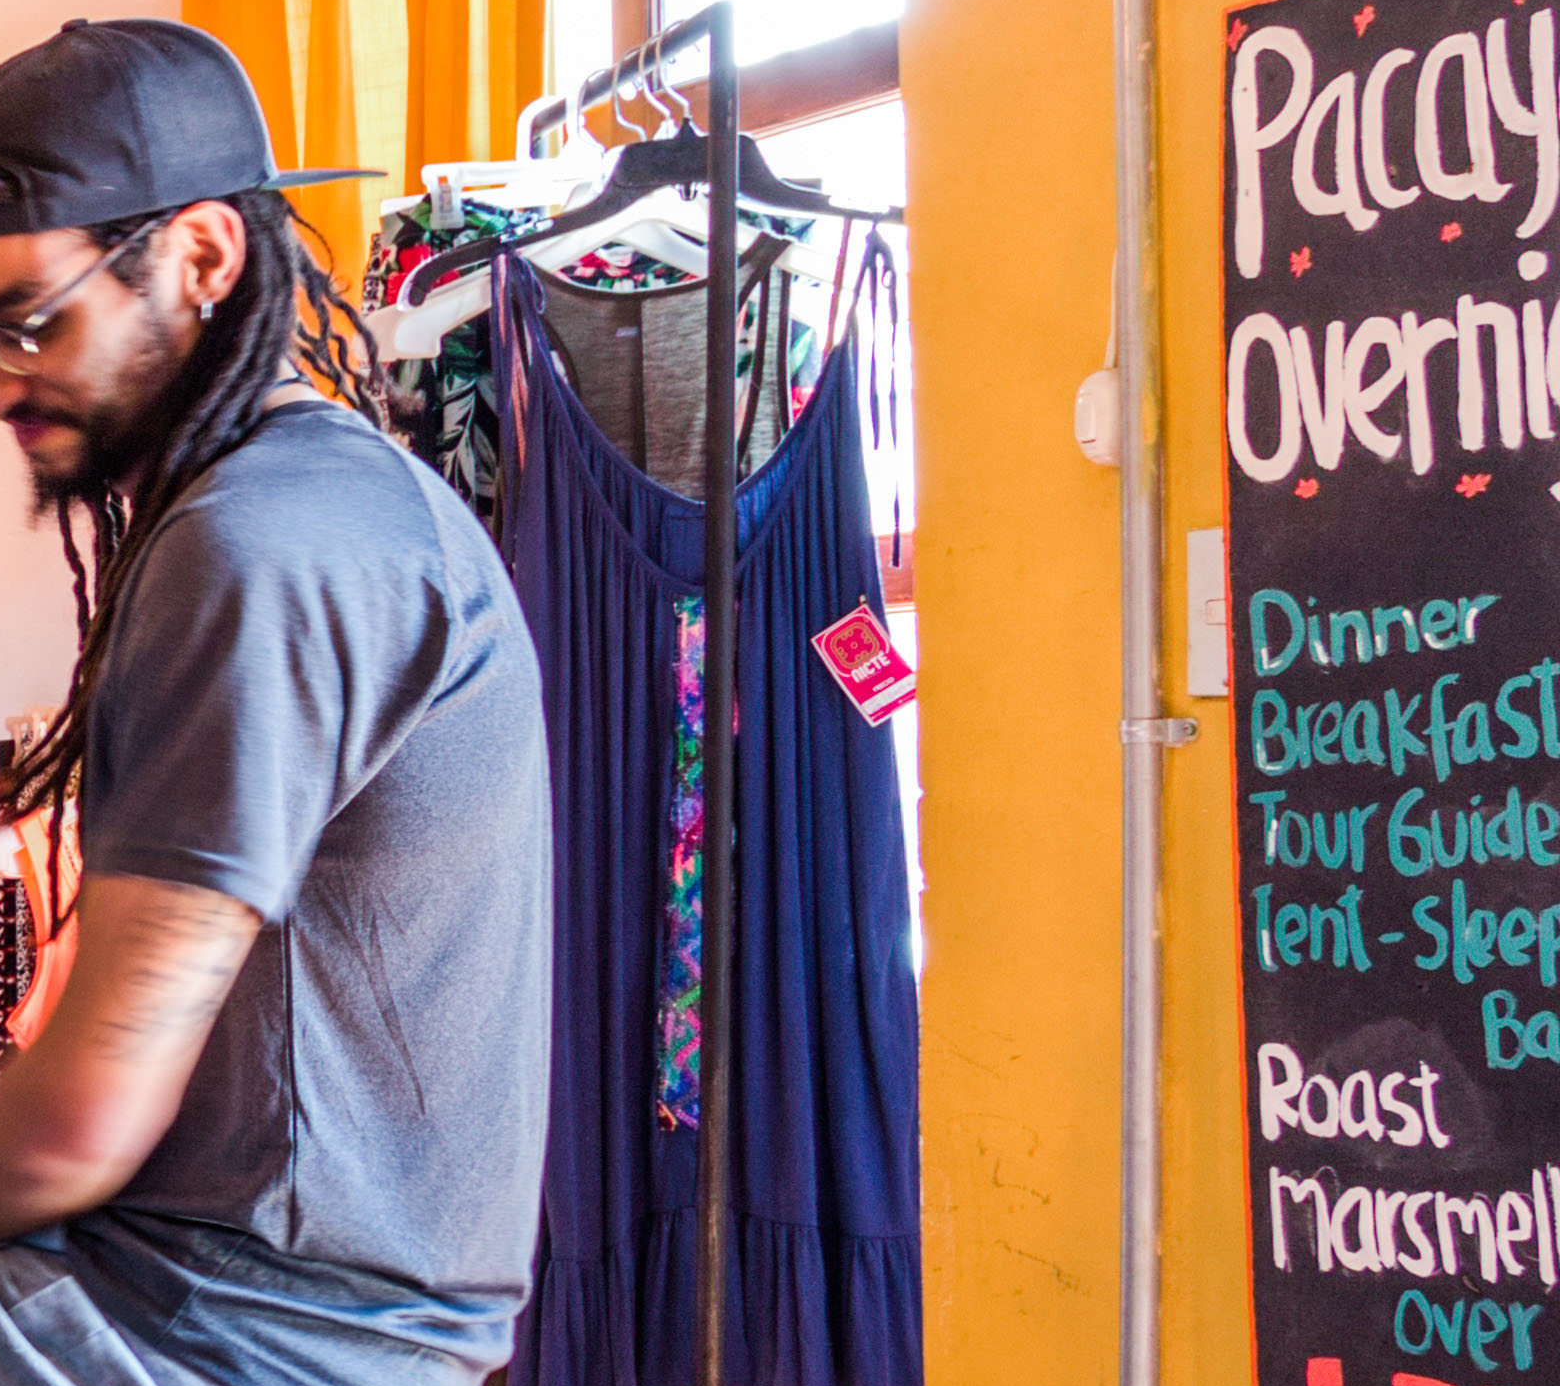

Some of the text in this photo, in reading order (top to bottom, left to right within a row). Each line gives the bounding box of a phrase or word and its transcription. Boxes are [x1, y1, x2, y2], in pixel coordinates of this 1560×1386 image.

[1231, 7, 1560, 280] Pacay
[1226, 249, 1560, 501] Overni
[1249, 589, 1502, 677] Dinner
[1249, 789, 1380, 874] Tour
[1257, 1042, 1453, 1148] Roast
